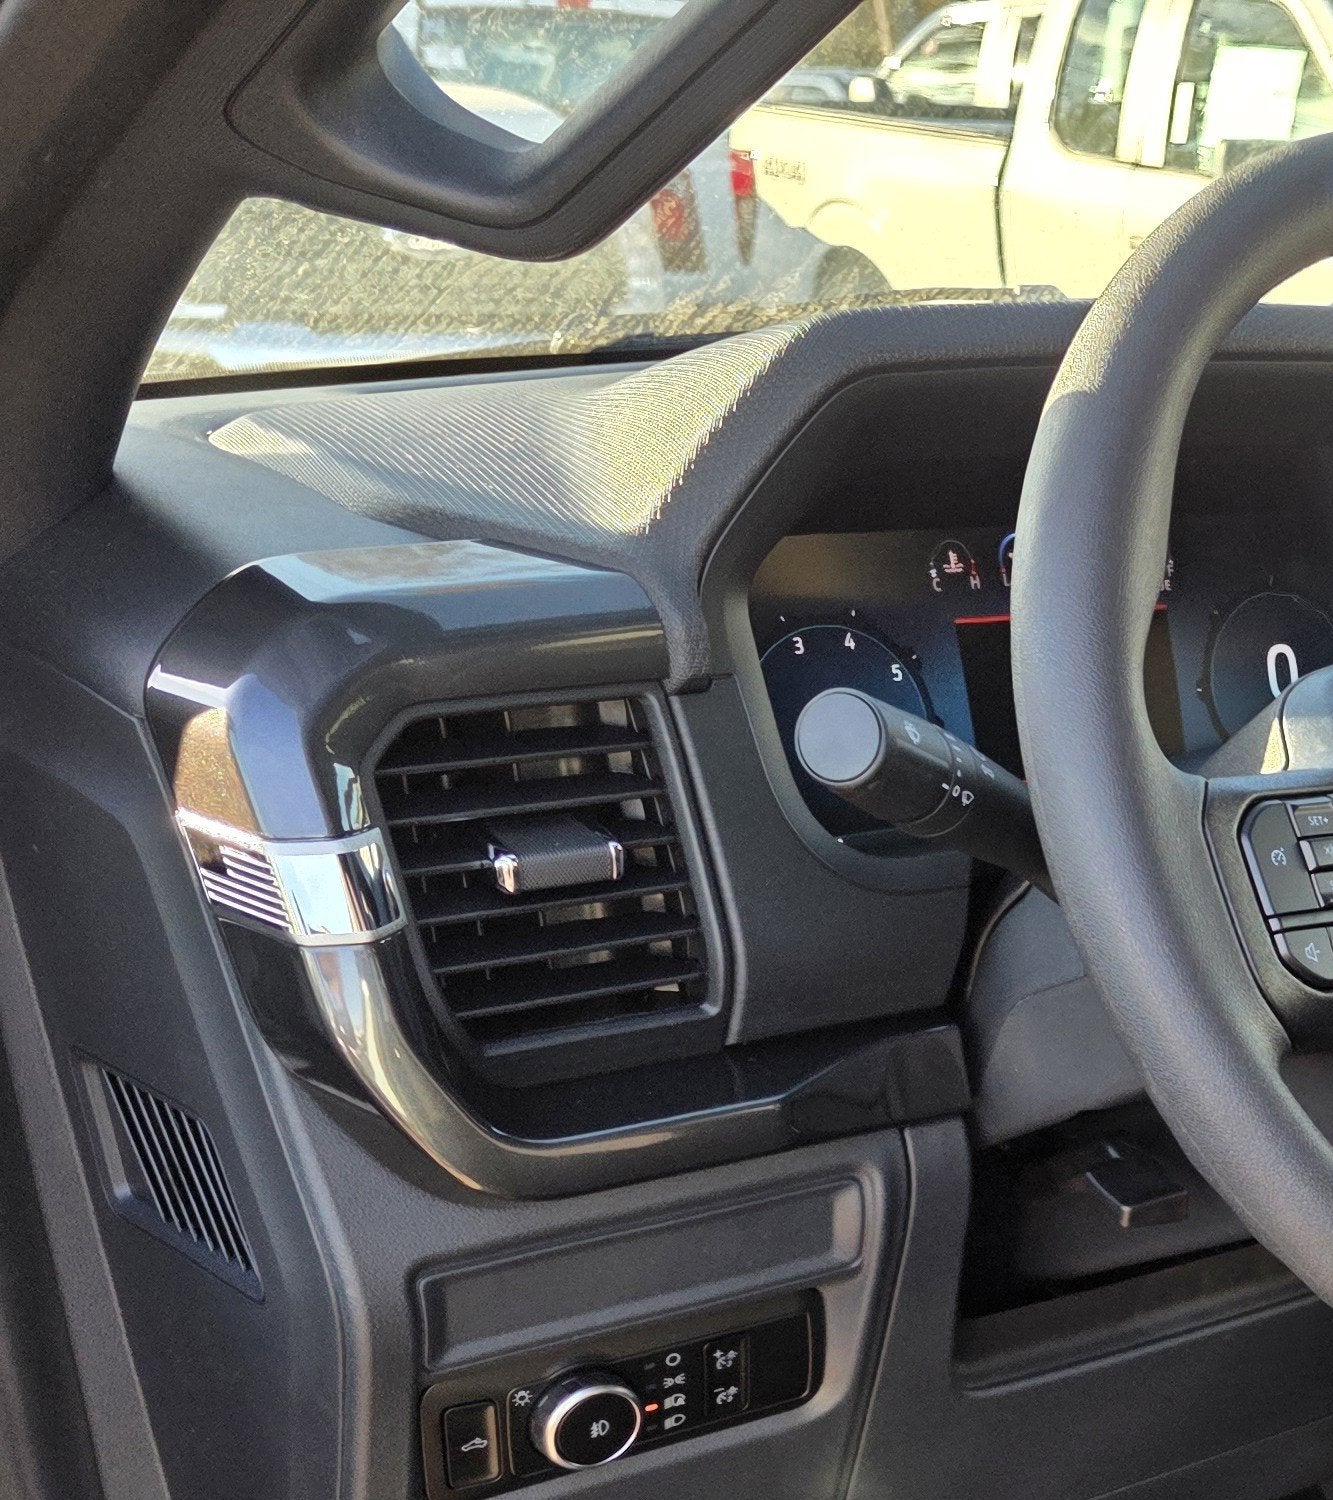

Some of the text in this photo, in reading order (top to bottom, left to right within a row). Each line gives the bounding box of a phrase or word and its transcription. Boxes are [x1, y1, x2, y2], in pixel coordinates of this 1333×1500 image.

[932, 578, 943, 592] C
[970, 575, 980, 590] H
[792, 636, 805, 655] 3
[844, 632, 856, 650] 4
[891, 663, 903, 682] 5
[1266, 643, 1299, 699] 0
